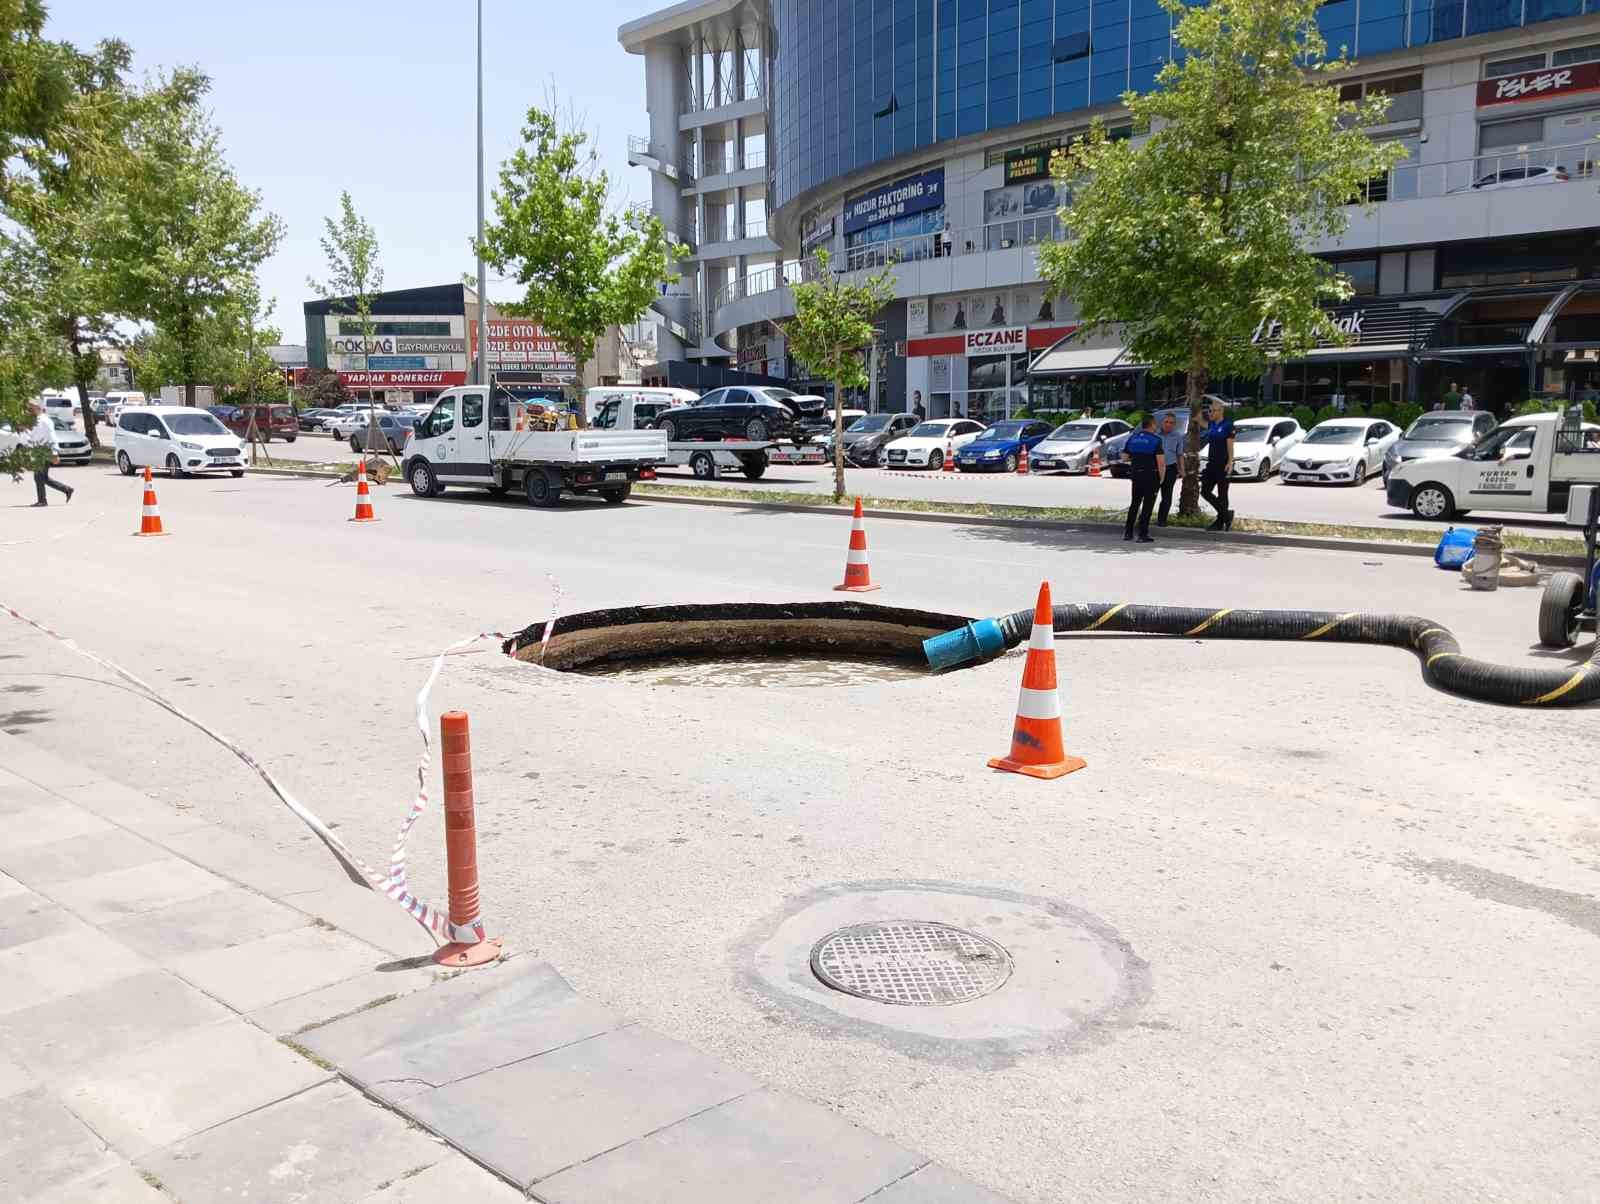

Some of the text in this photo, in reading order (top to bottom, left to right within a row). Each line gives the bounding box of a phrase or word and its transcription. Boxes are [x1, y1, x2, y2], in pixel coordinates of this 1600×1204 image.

[512, 324, 534, 337] OTO
[967, 329, 1024, 348] ECZANE
[514, 340, 534, 352] OTO
